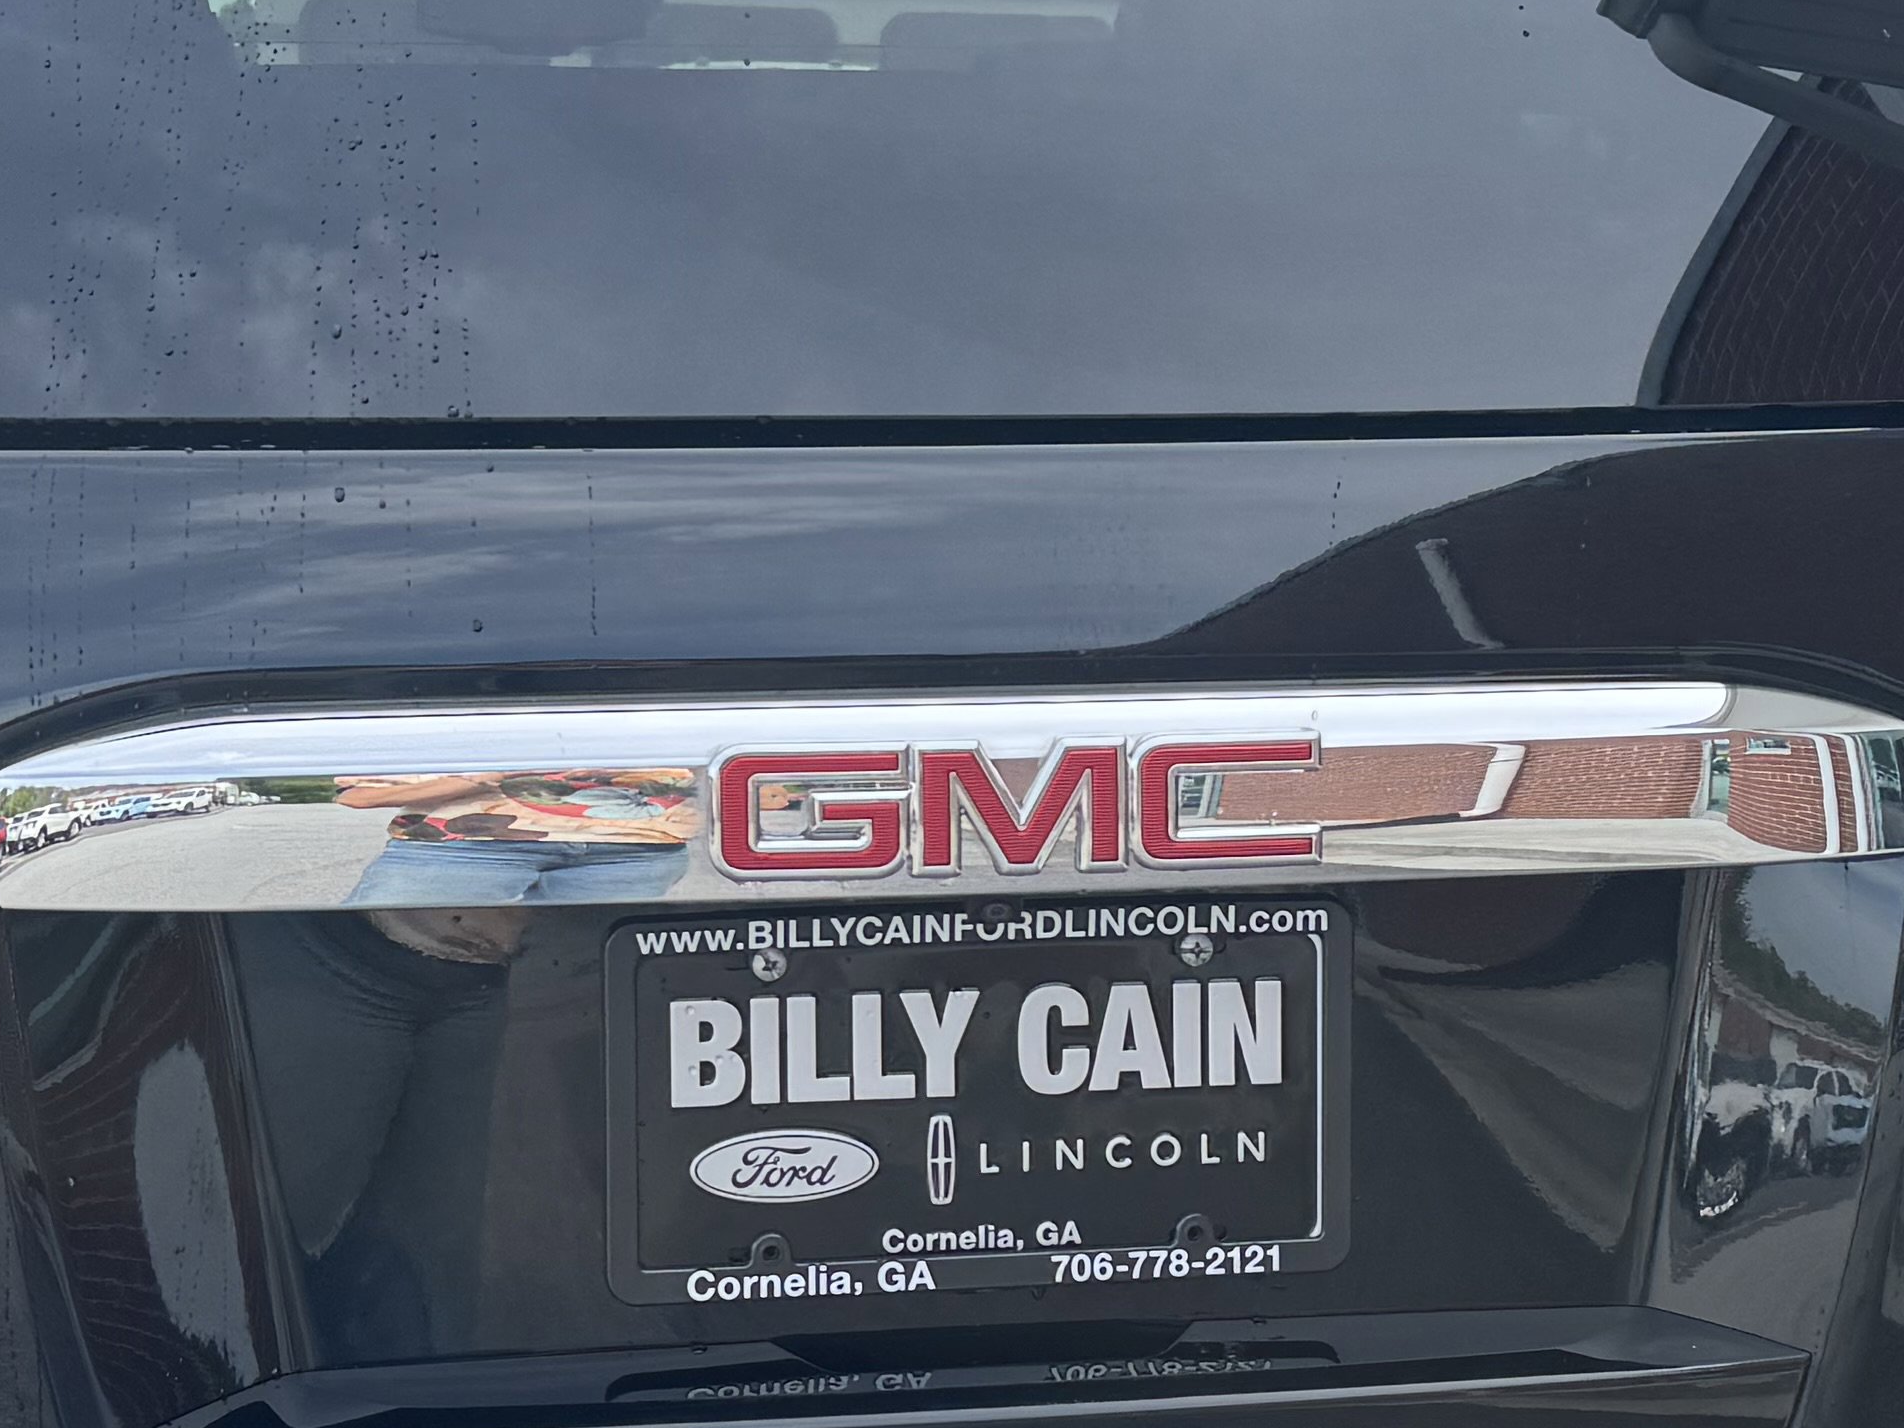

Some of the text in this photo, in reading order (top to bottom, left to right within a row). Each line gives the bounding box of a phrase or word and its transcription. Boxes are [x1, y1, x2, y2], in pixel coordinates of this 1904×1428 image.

[708, 729, 1322, 879] GMC
[669, 977, 1283, 1108] BILLY CAIN
[978, 1130, 1267, 1174] LINCOLN
[881, 1220, 1082, 1254] Cornelia, GA
[686, 1259, 937, 1302] Cornelia, GA
[1050, 1244, 1282, 1284] 706-778-2121
